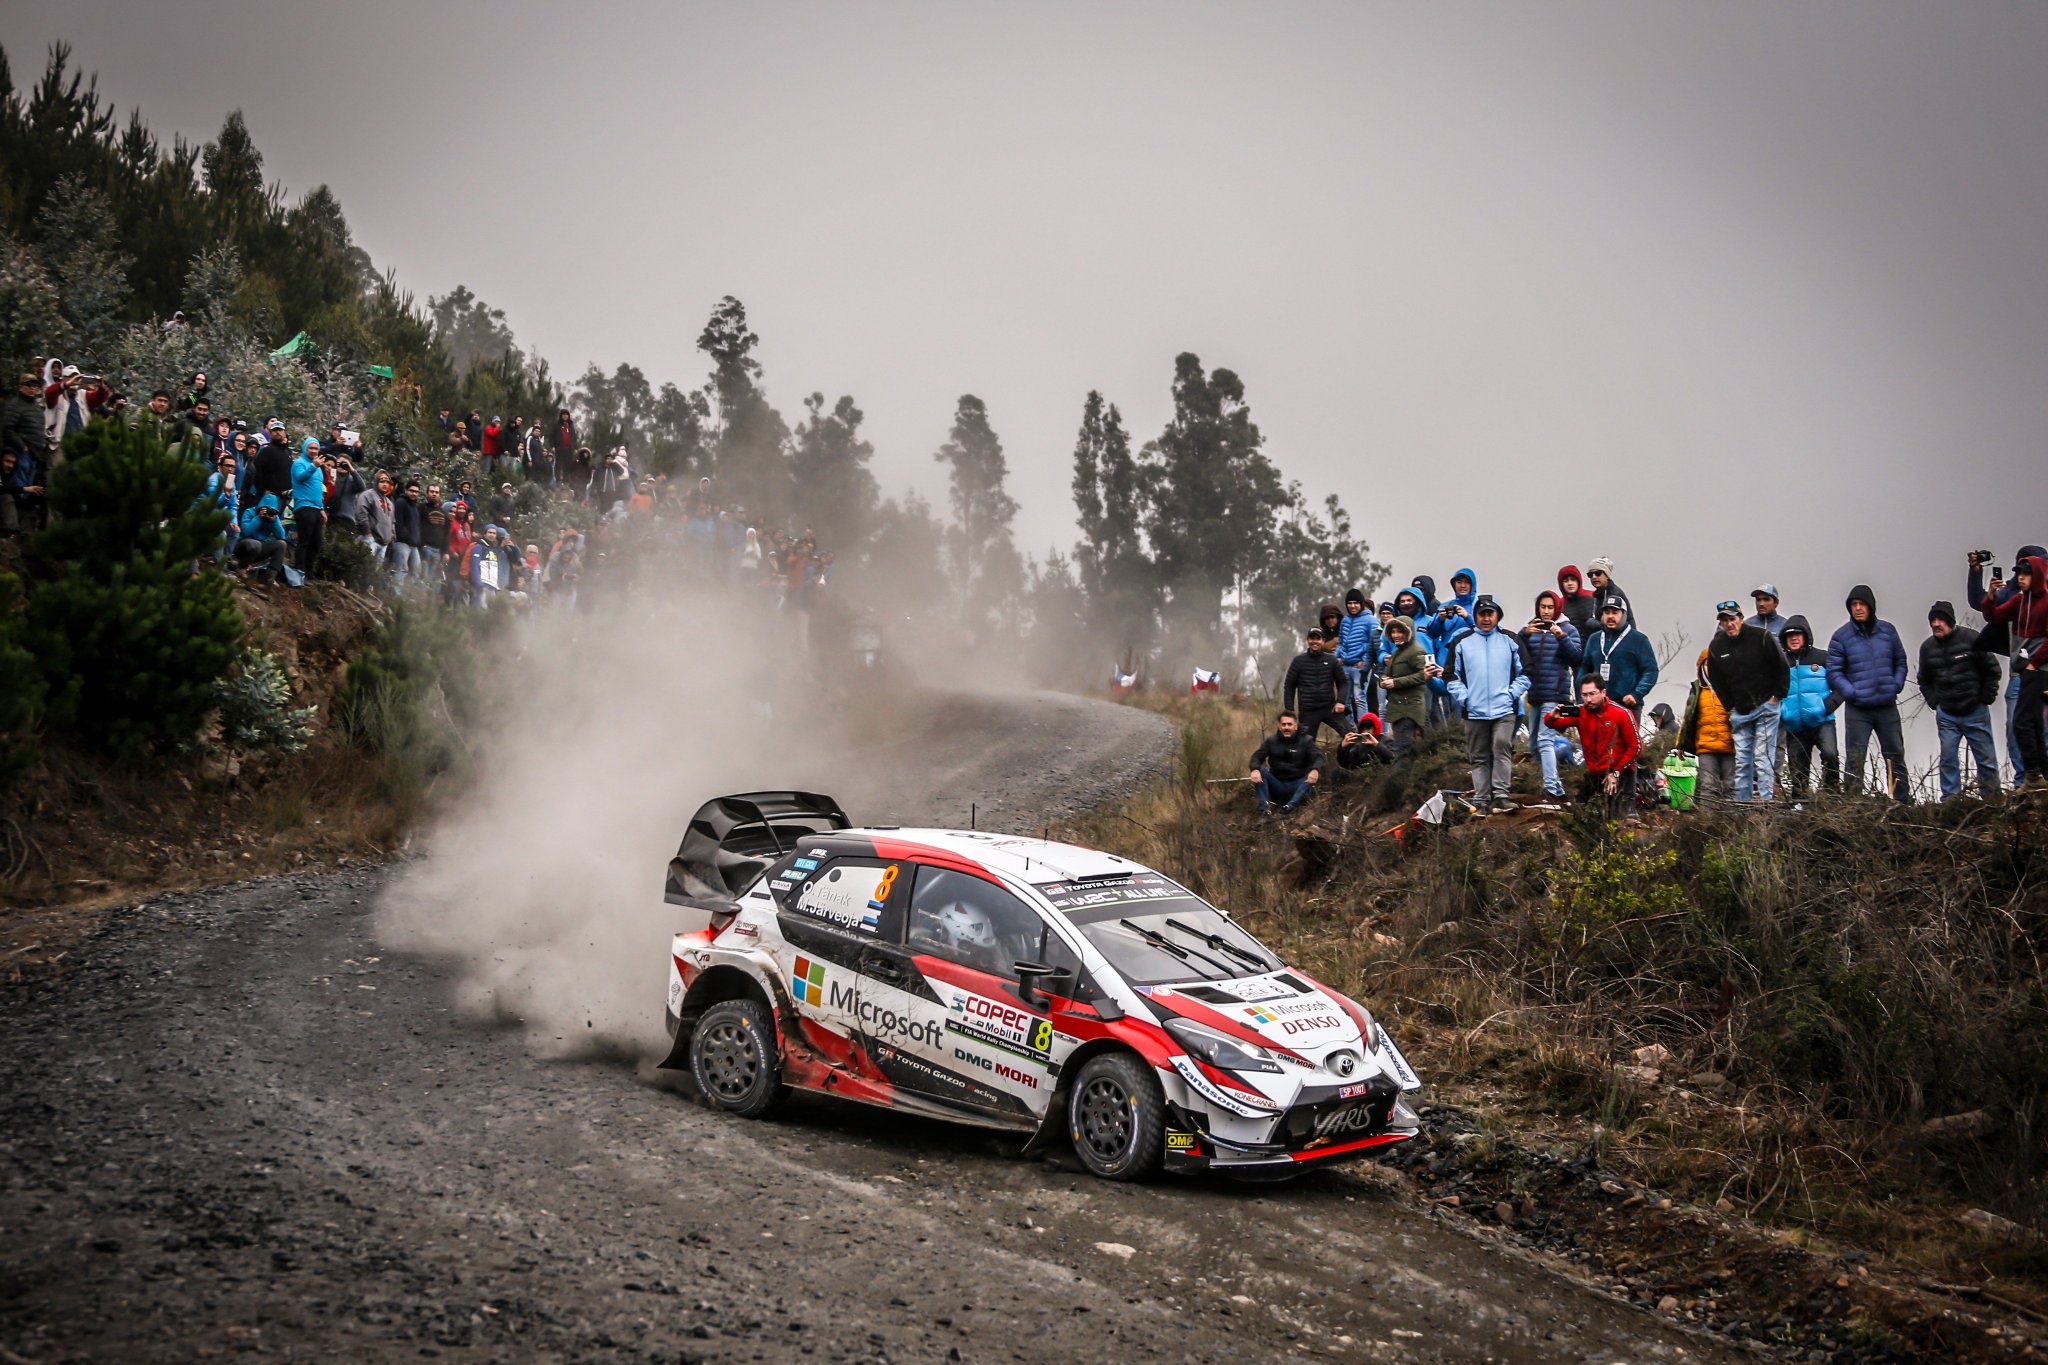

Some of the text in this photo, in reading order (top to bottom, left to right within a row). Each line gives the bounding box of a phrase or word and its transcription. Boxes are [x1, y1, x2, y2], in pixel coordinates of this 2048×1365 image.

[874, 864, 899, 902] 8
[1065, 883, 1102, 892] TOYOTA
[1104, 879, 1135, 887] GAZOO
[830, 980, 943, 1050] Microsoft
[1269, 1001, 1333, 1016] Microsoft
[985, 1021, 1012, 1039] Mobil
[1281, 1015, 1341, 1035] DENSO
[973, 1030, 987, 1040] World
[987, 1034, 999, 1045] Rally
[999, 1040, 1030, 1056] Championship
[1035, 1022, 1052, 1051] 8
[955, 1048, 1038, 1089] DMG MORI
[1261, 1064, 1278, 1072] PIAA
[1277, 1053, 1316, 1071] DMG MORI
[896, 1054, 931, 1074] TOYOTA
[932, 1070, 966, 1088] GAZOO
[966, 1084, 998, 1102] Racing
[1176, 1062, 1248, 1115] Panasonic
[1343, 1086, 1351, 1096] SP
[1234, 1091, 1278, 1109] KONECRANES
[1312, 1103, 1375, 1138] YARIS
[1168, 1136, 1194, 1146] OMP
